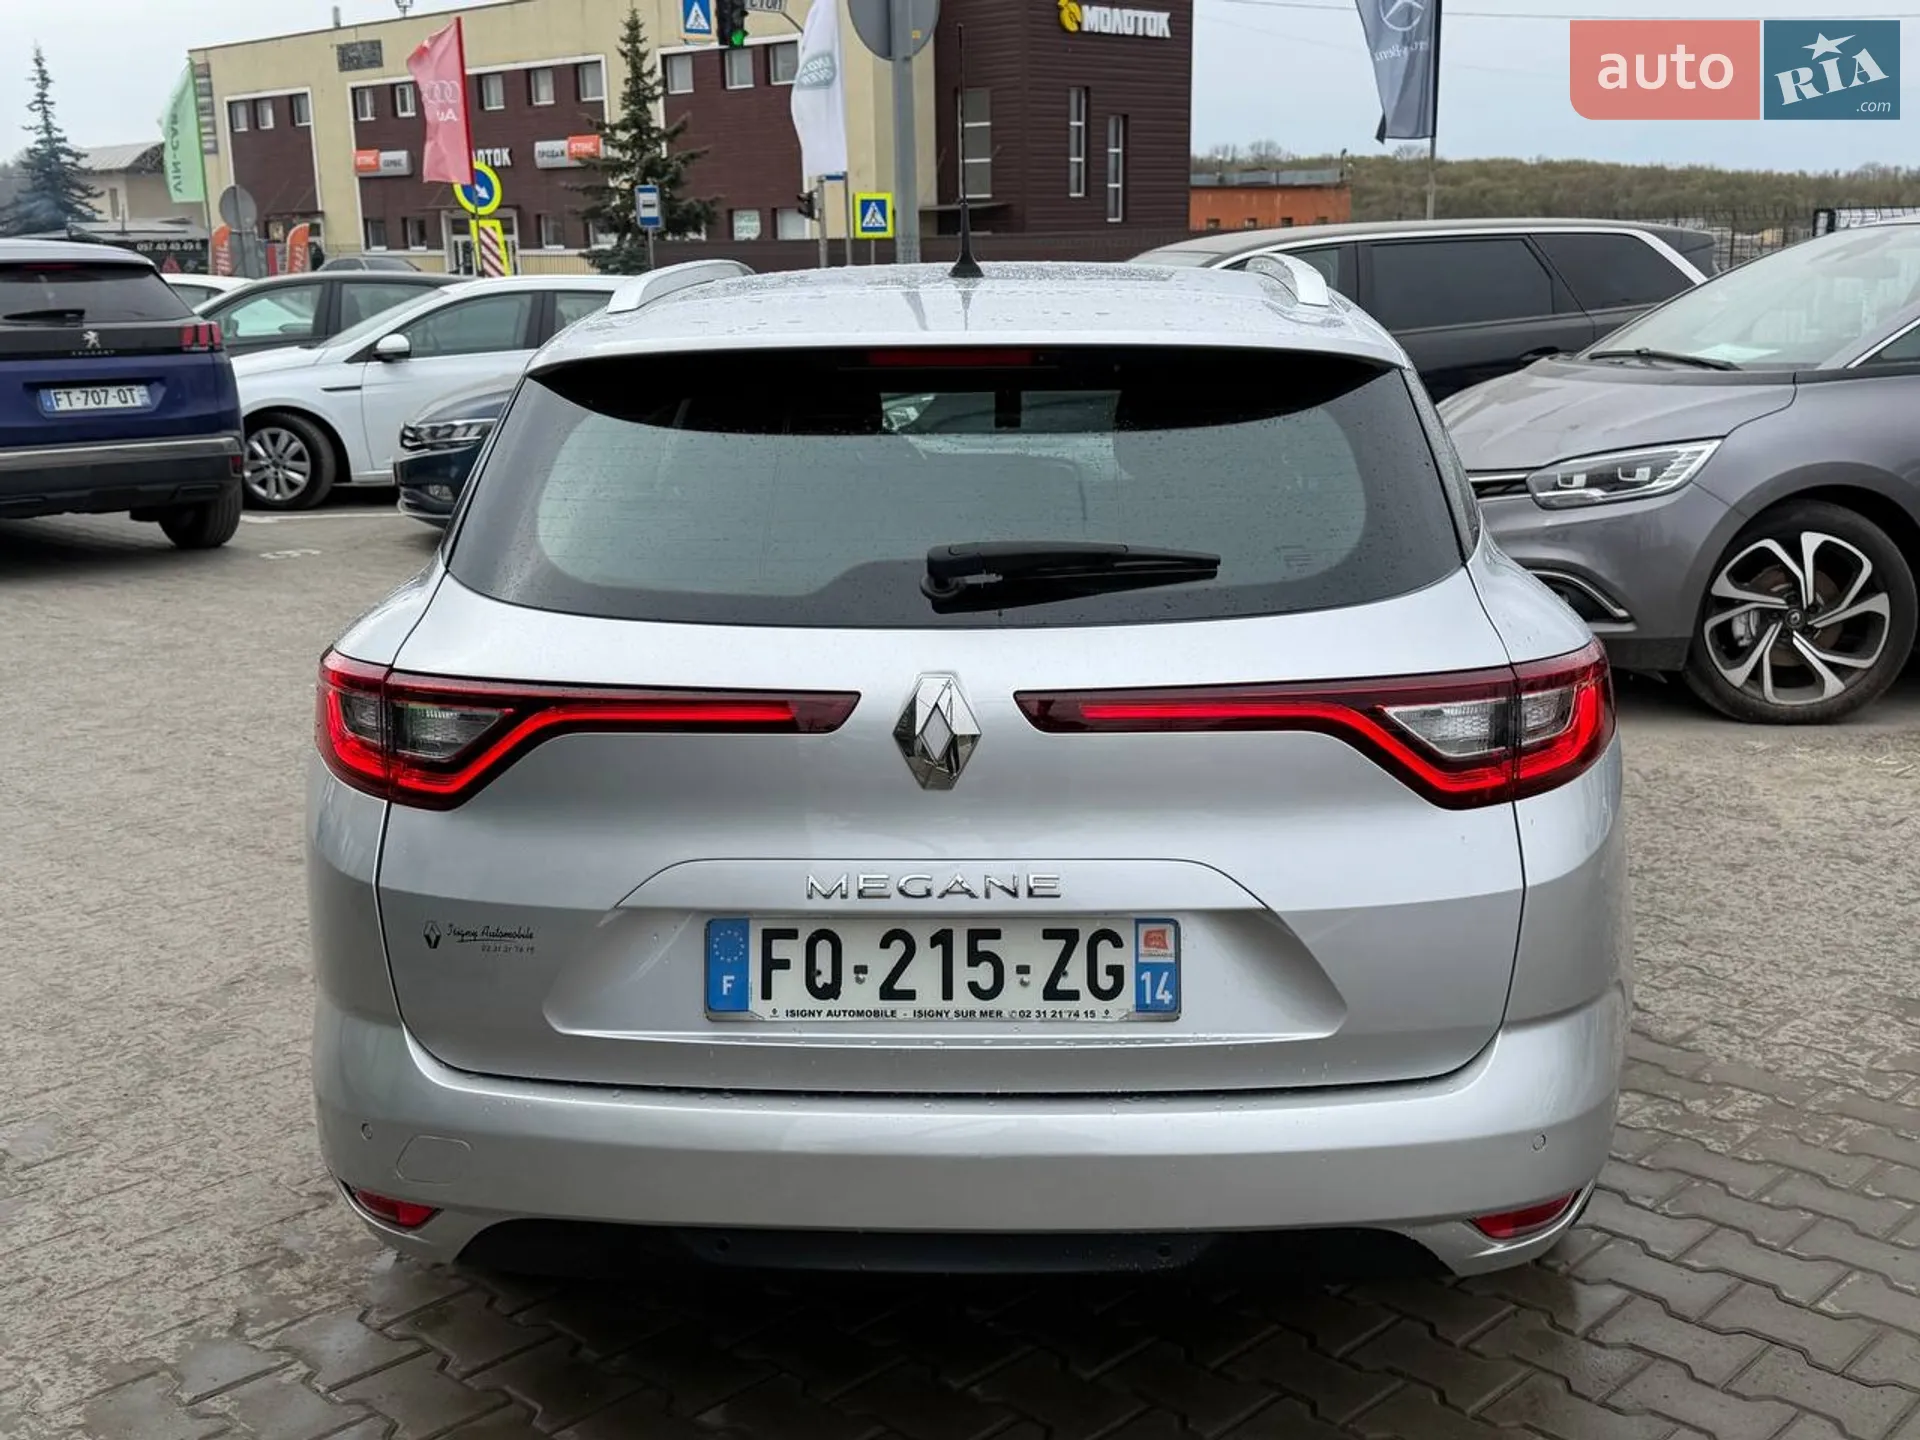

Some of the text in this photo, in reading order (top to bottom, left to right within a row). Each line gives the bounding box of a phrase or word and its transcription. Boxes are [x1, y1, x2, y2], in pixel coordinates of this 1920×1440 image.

[1081, 5, 1171, 38] МОЛОТОК
[53, 387, 137, 408] FT-707-QT
[806, 873, 1063, 900] MEGANE
[761, 928, 1125, 1001] FQ-215-ZG
[722, 975, 735, 995] F
[1141, 971, 1173, 1005] 14
[785, 1009, 823, 1018] ISIGNY
[826, 1009, 897, 1018] AUTOMOBILE
[913, 1009, 951, 1018] ISIGNY
[954, 1009, 976, 1018] SUR
[979, 1009, 1003, 1018] MER
[1018, 1009, 1032, 1018] 02
[1035, 1009, 1047, 1018] 31
[1083, 1009, 1096, 1018] 15
